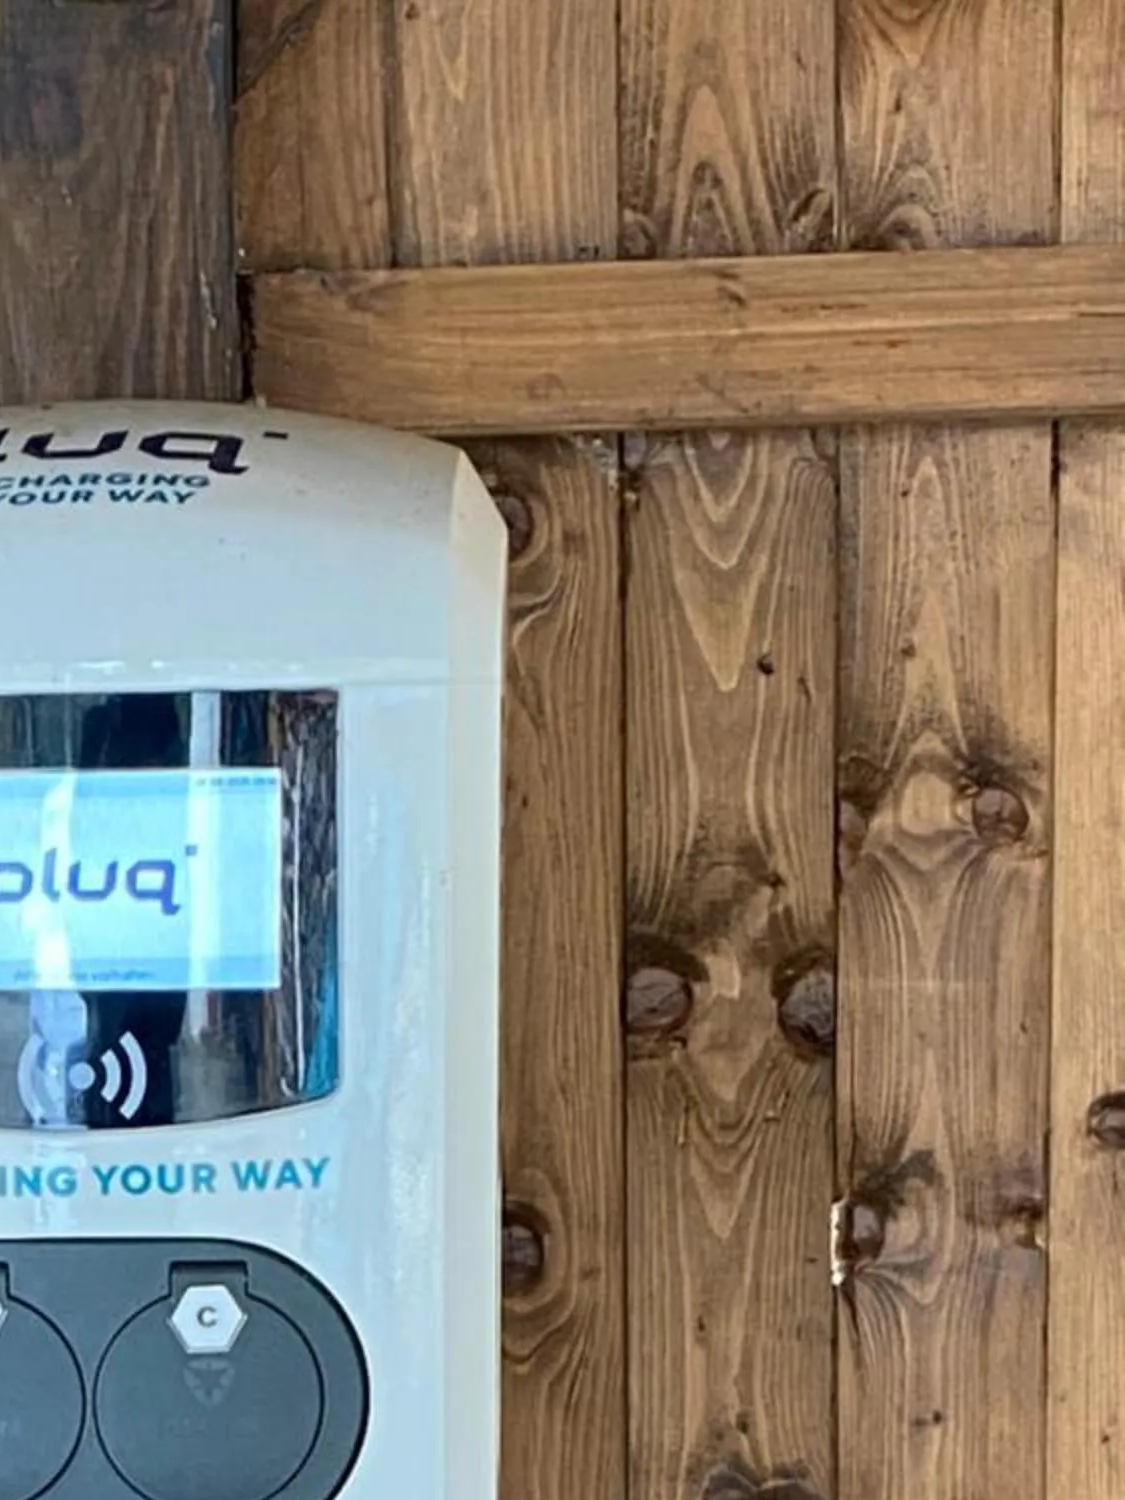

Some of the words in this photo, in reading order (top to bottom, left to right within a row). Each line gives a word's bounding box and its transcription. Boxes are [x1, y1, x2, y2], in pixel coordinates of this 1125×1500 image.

[107, 489, 196, 505] WAY
[91, 1162, 217, 1196] YOUR
[230, 1156, 331, 1193] WAY
[196, 1306, 218, 1328] C
